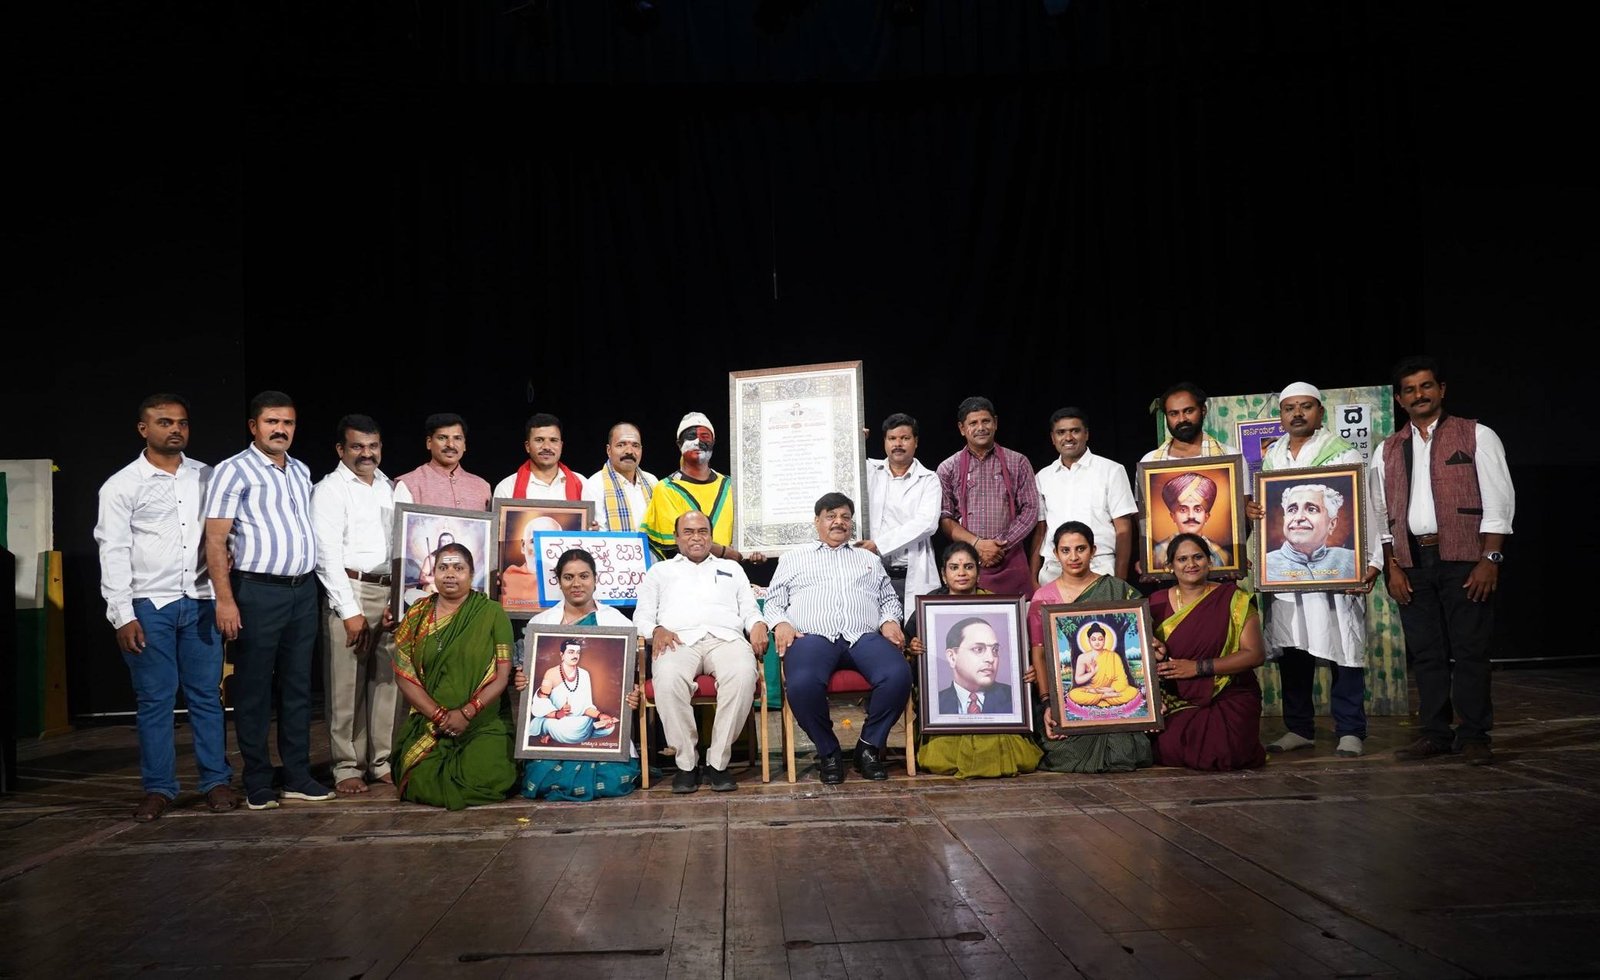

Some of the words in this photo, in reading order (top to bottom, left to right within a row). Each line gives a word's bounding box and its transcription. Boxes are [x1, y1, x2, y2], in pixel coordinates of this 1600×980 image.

[1344, 407, 1363, 424] ದ
[1340, 428, 1351, 438] ರ
[1357, 427, 1368, 437] ಗ
[609, 586, 638, 599] ಪಂಪ
